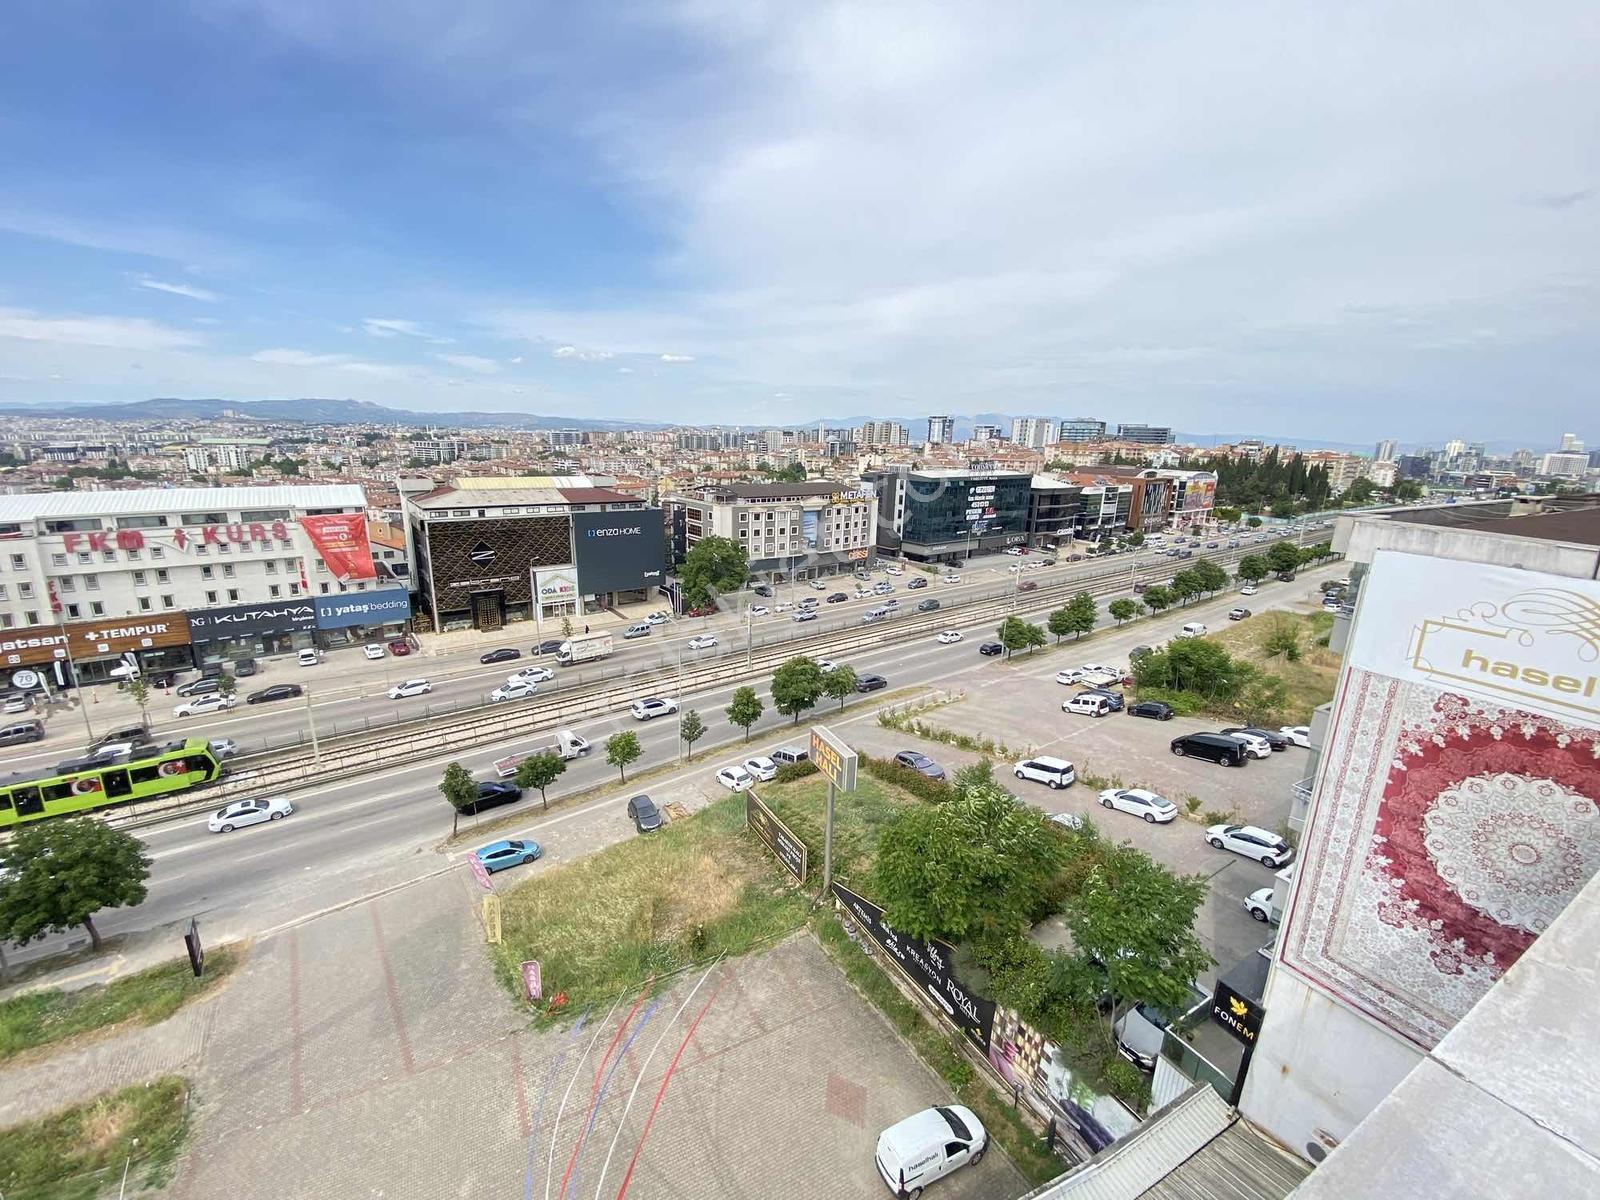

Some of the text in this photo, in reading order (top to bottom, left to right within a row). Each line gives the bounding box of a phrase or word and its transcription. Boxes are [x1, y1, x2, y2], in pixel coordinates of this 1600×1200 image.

[63, 522, 290, 553] FKM KURS
[596, 527, 641, 536] enza HOME
[191, 617, 205, 627] NG
[335, 599, 408, 617] yataş bedding
[101, 624, 169, 639] TEMPUR
[1461, 649, 1598, 698] hasel
[812, 734, 842, 772] HASEL
[906, 945, 942, 984] KREASYON
[946, 978, 980, 1024] ROYAL
[1214, 1006, 1254, 1041] FONEM
